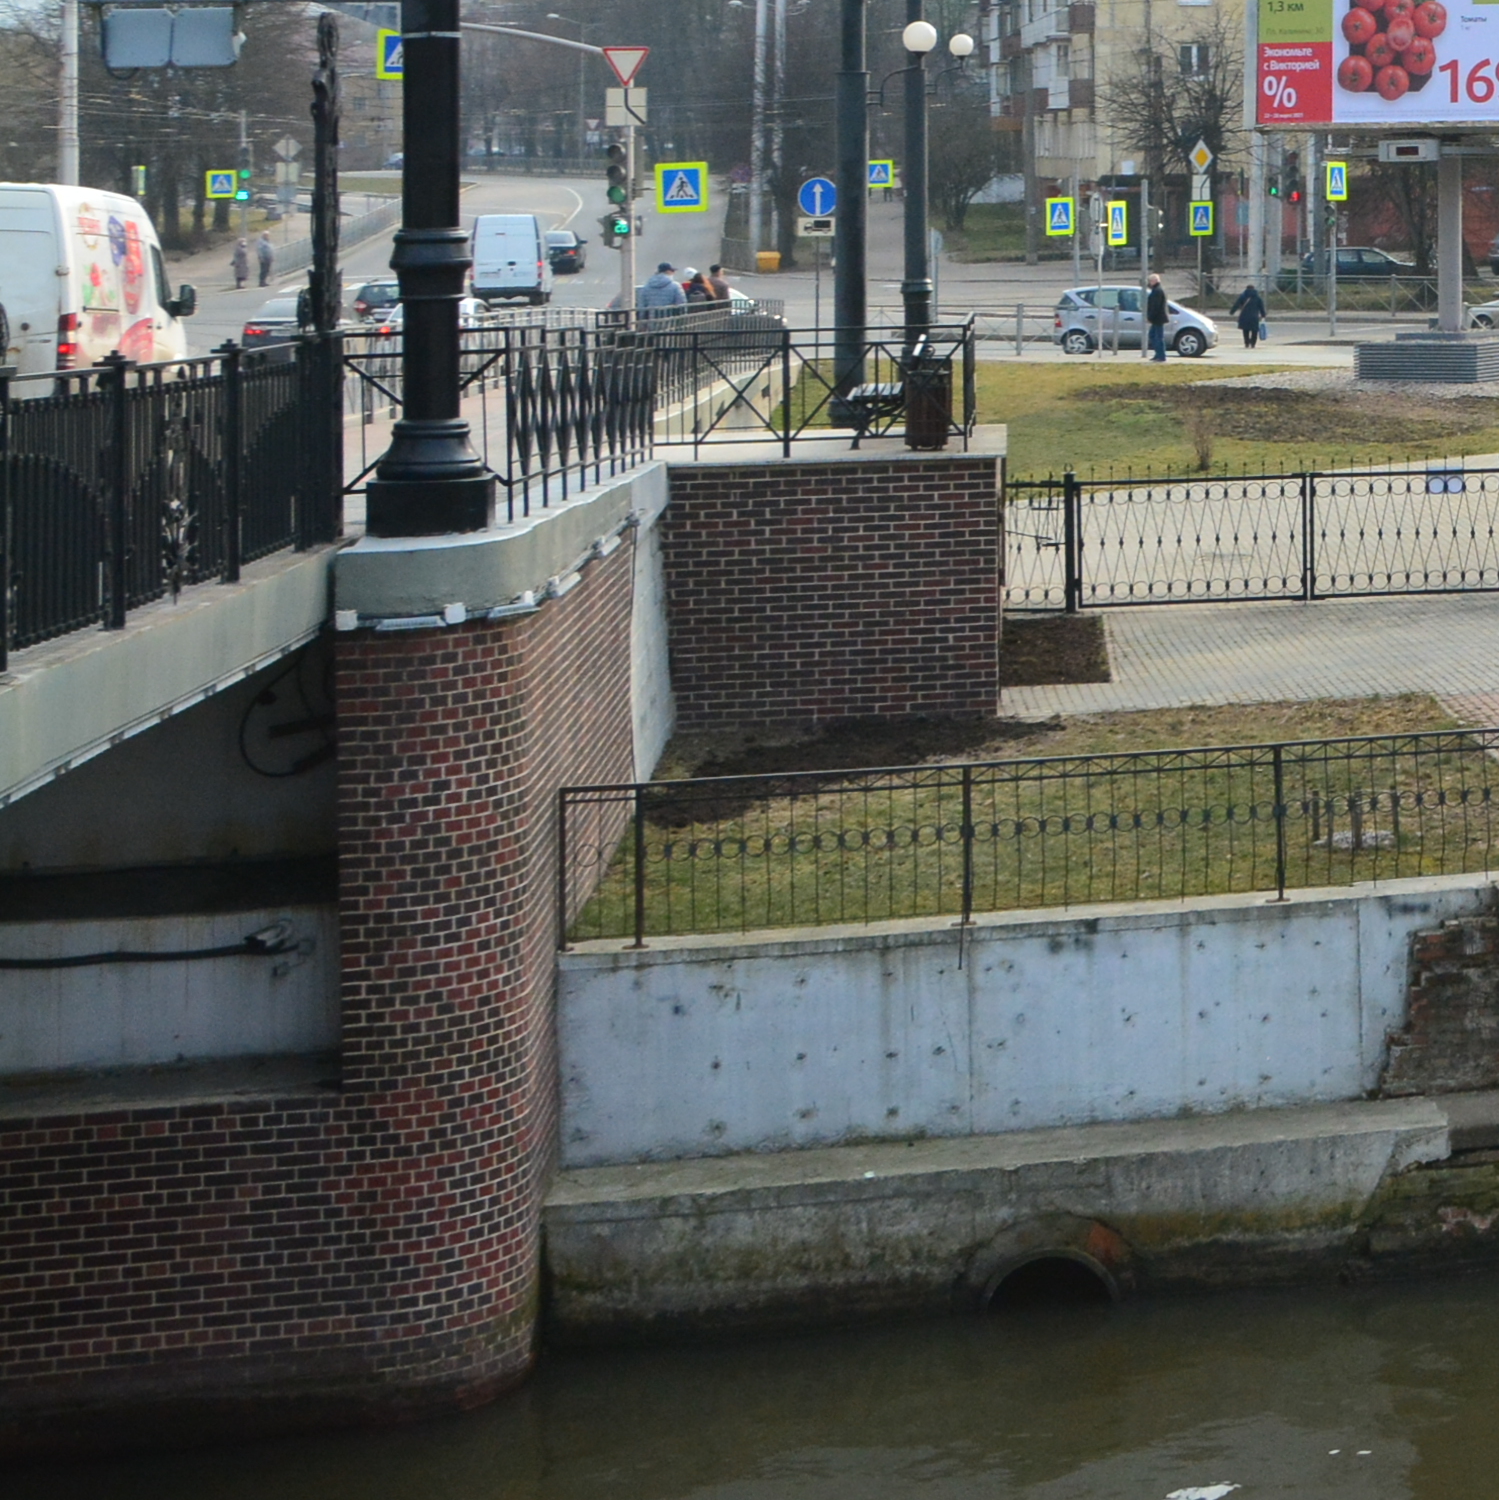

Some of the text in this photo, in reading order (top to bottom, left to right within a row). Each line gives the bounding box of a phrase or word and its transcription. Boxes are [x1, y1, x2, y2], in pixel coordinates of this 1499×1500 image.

[1267, 1, 1304, 14] 1,3 км
[1263, 47, 1313, 57] Экономьте
[1270, 59, 1320, 72] Викторией
[1263, 75, 1297, 108] %
